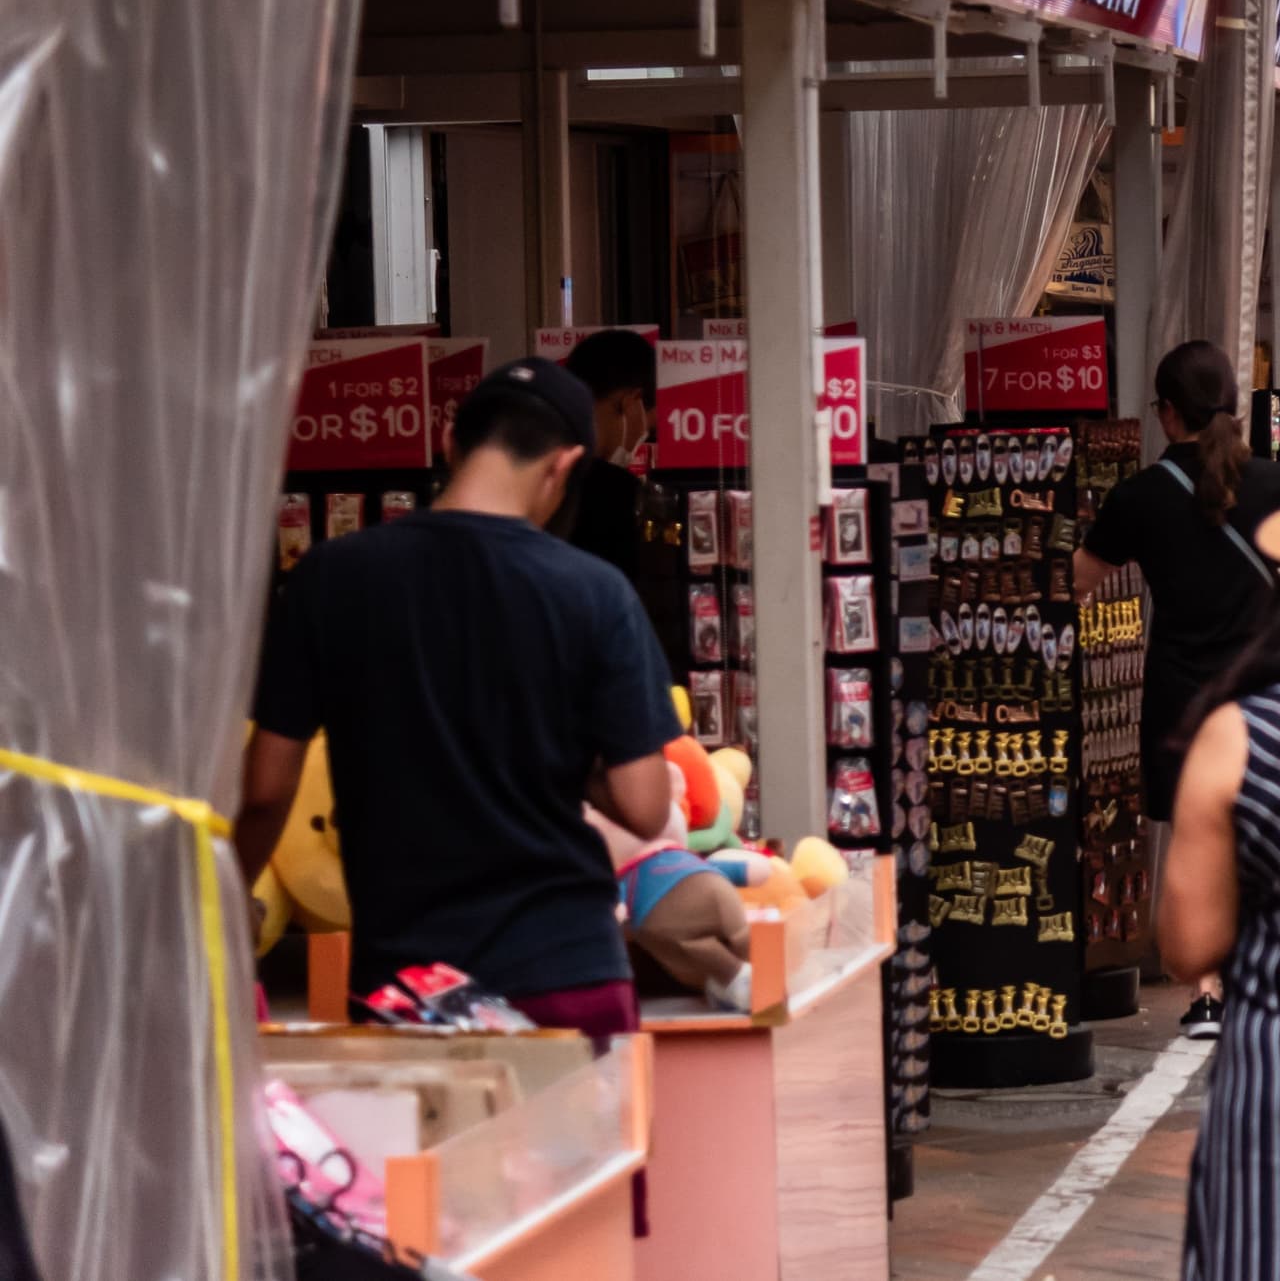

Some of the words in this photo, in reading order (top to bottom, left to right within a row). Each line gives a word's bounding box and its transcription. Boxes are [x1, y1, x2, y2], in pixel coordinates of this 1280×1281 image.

[1052, 348, 1079, 359] FOR
[1081, 345, 1102, 360] $3
[328, 381, 336, 398] 1
[343, 383, 383, 398] FOR
[388, 377, 419, 398] $2
[827, 377, 857, 400] $2
[984, 369, 999, 391] 7
[1003, 370, 1053, 391] FOR
[1056, 364, 1103, 393] $10
[290, 414, 343, 441] OR
[349, 404, 420, 442] $10
[667, 408, 705, 442] 10
